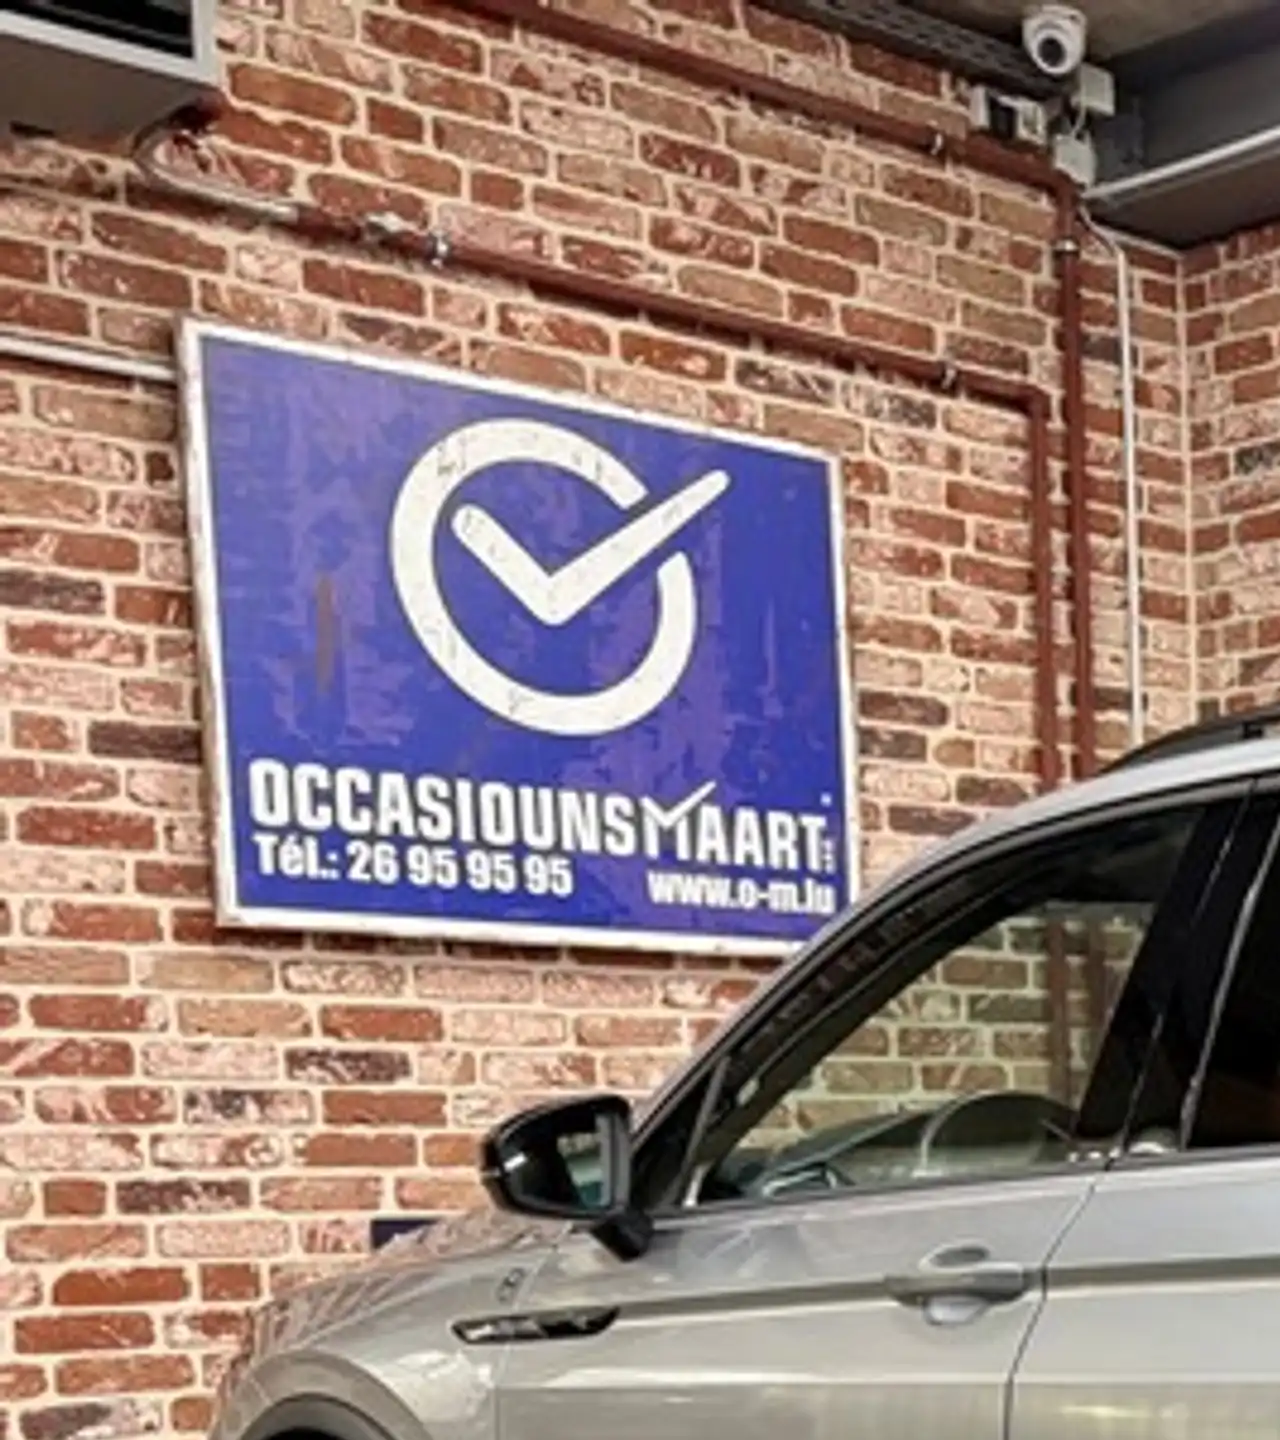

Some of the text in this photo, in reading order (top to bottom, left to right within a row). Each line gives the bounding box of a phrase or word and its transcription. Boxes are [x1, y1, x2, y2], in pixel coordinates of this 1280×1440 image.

[346, 838, 400, 885] 26
[407, 844, 460, 890] 95
[466, 849, 518, 894] 95
[523, 853, 574, 898] 95
[647, 868, 836, 914] www.o-m.lu
